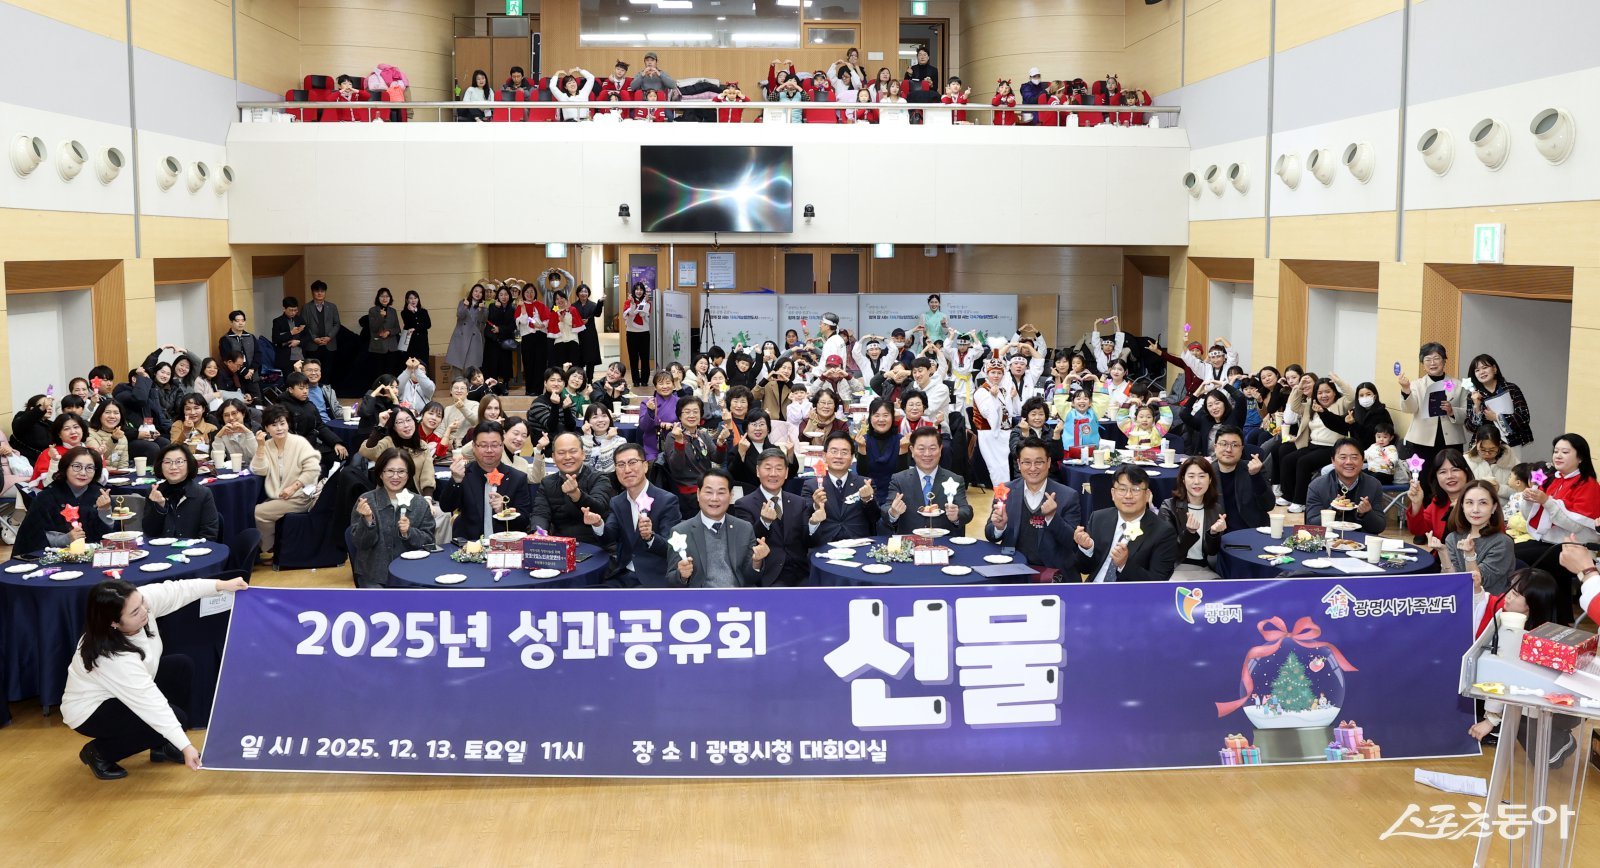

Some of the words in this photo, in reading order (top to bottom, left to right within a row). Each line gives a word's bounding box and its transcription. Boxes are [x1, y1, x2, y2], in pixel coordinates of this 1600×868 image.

[1326, 606, 1349, 618] 센터
[1328, 594, 1349, 607] 가족
[1353, 595, 1456, 617] 광명시가족센터
[1204, 608, 1242, 623] 광명시
[296, 610, 490, 669] 2025년
[508, 607, 767, 670] 성과공유회
[823, 594, 1064, 728] 선물
[316, 737, 380, 758] 2025.
[388, 739, 418, 759] 12.
[426, 740, 457, 760] 13.
[464, 740, 528, 763] 토요일
[541, 741, 585, 761] 11시
[706, 739, 793, 765] 광명시청
[799, 738, 888, 763] 대회의실
